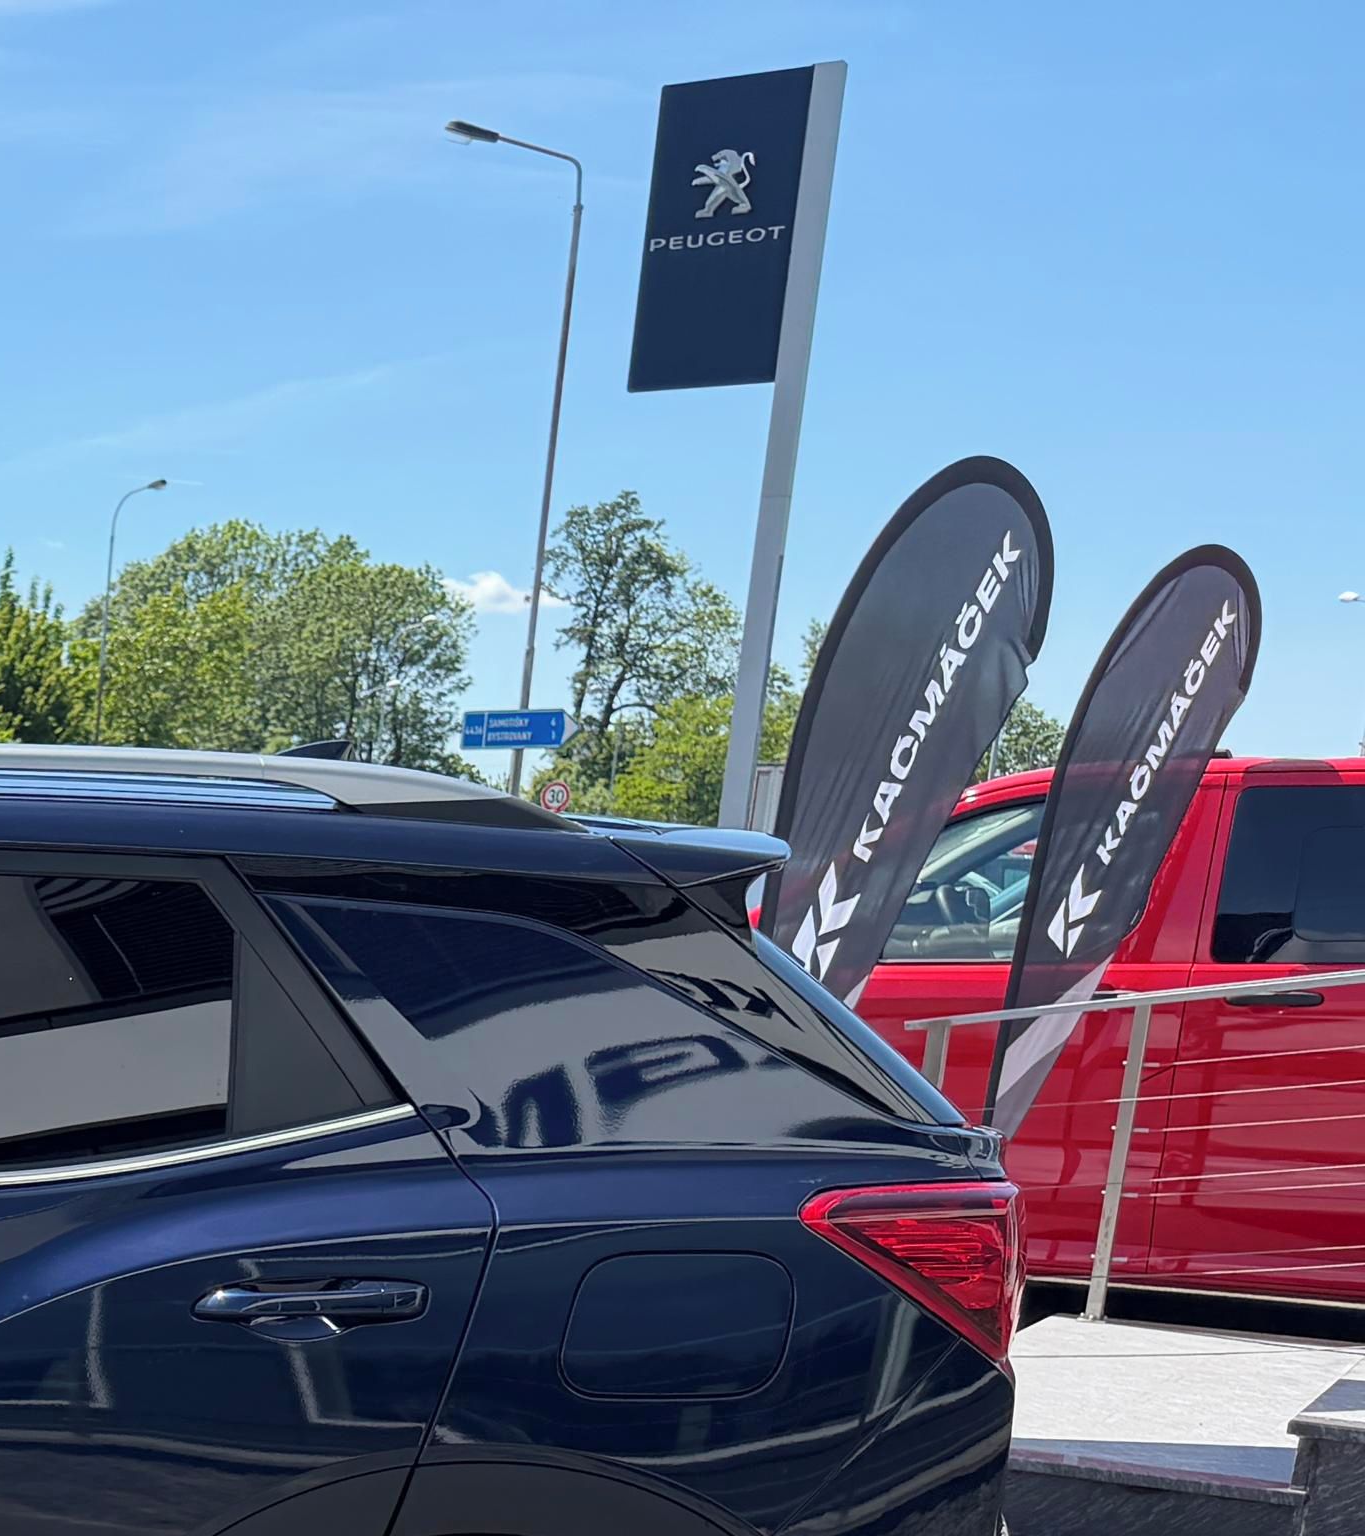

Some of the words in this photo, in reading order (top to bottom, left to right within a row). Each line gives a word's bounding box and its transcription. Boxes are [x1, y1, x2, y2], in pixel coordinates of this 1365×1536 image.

[649, 225, 786, 252] PEUGEOT
[853, 530, 1021, 864] KAČMÁČEK
[1095, 599, 1237, 867] KAČMÁČEK
[548, 789, 566, 804] 30
